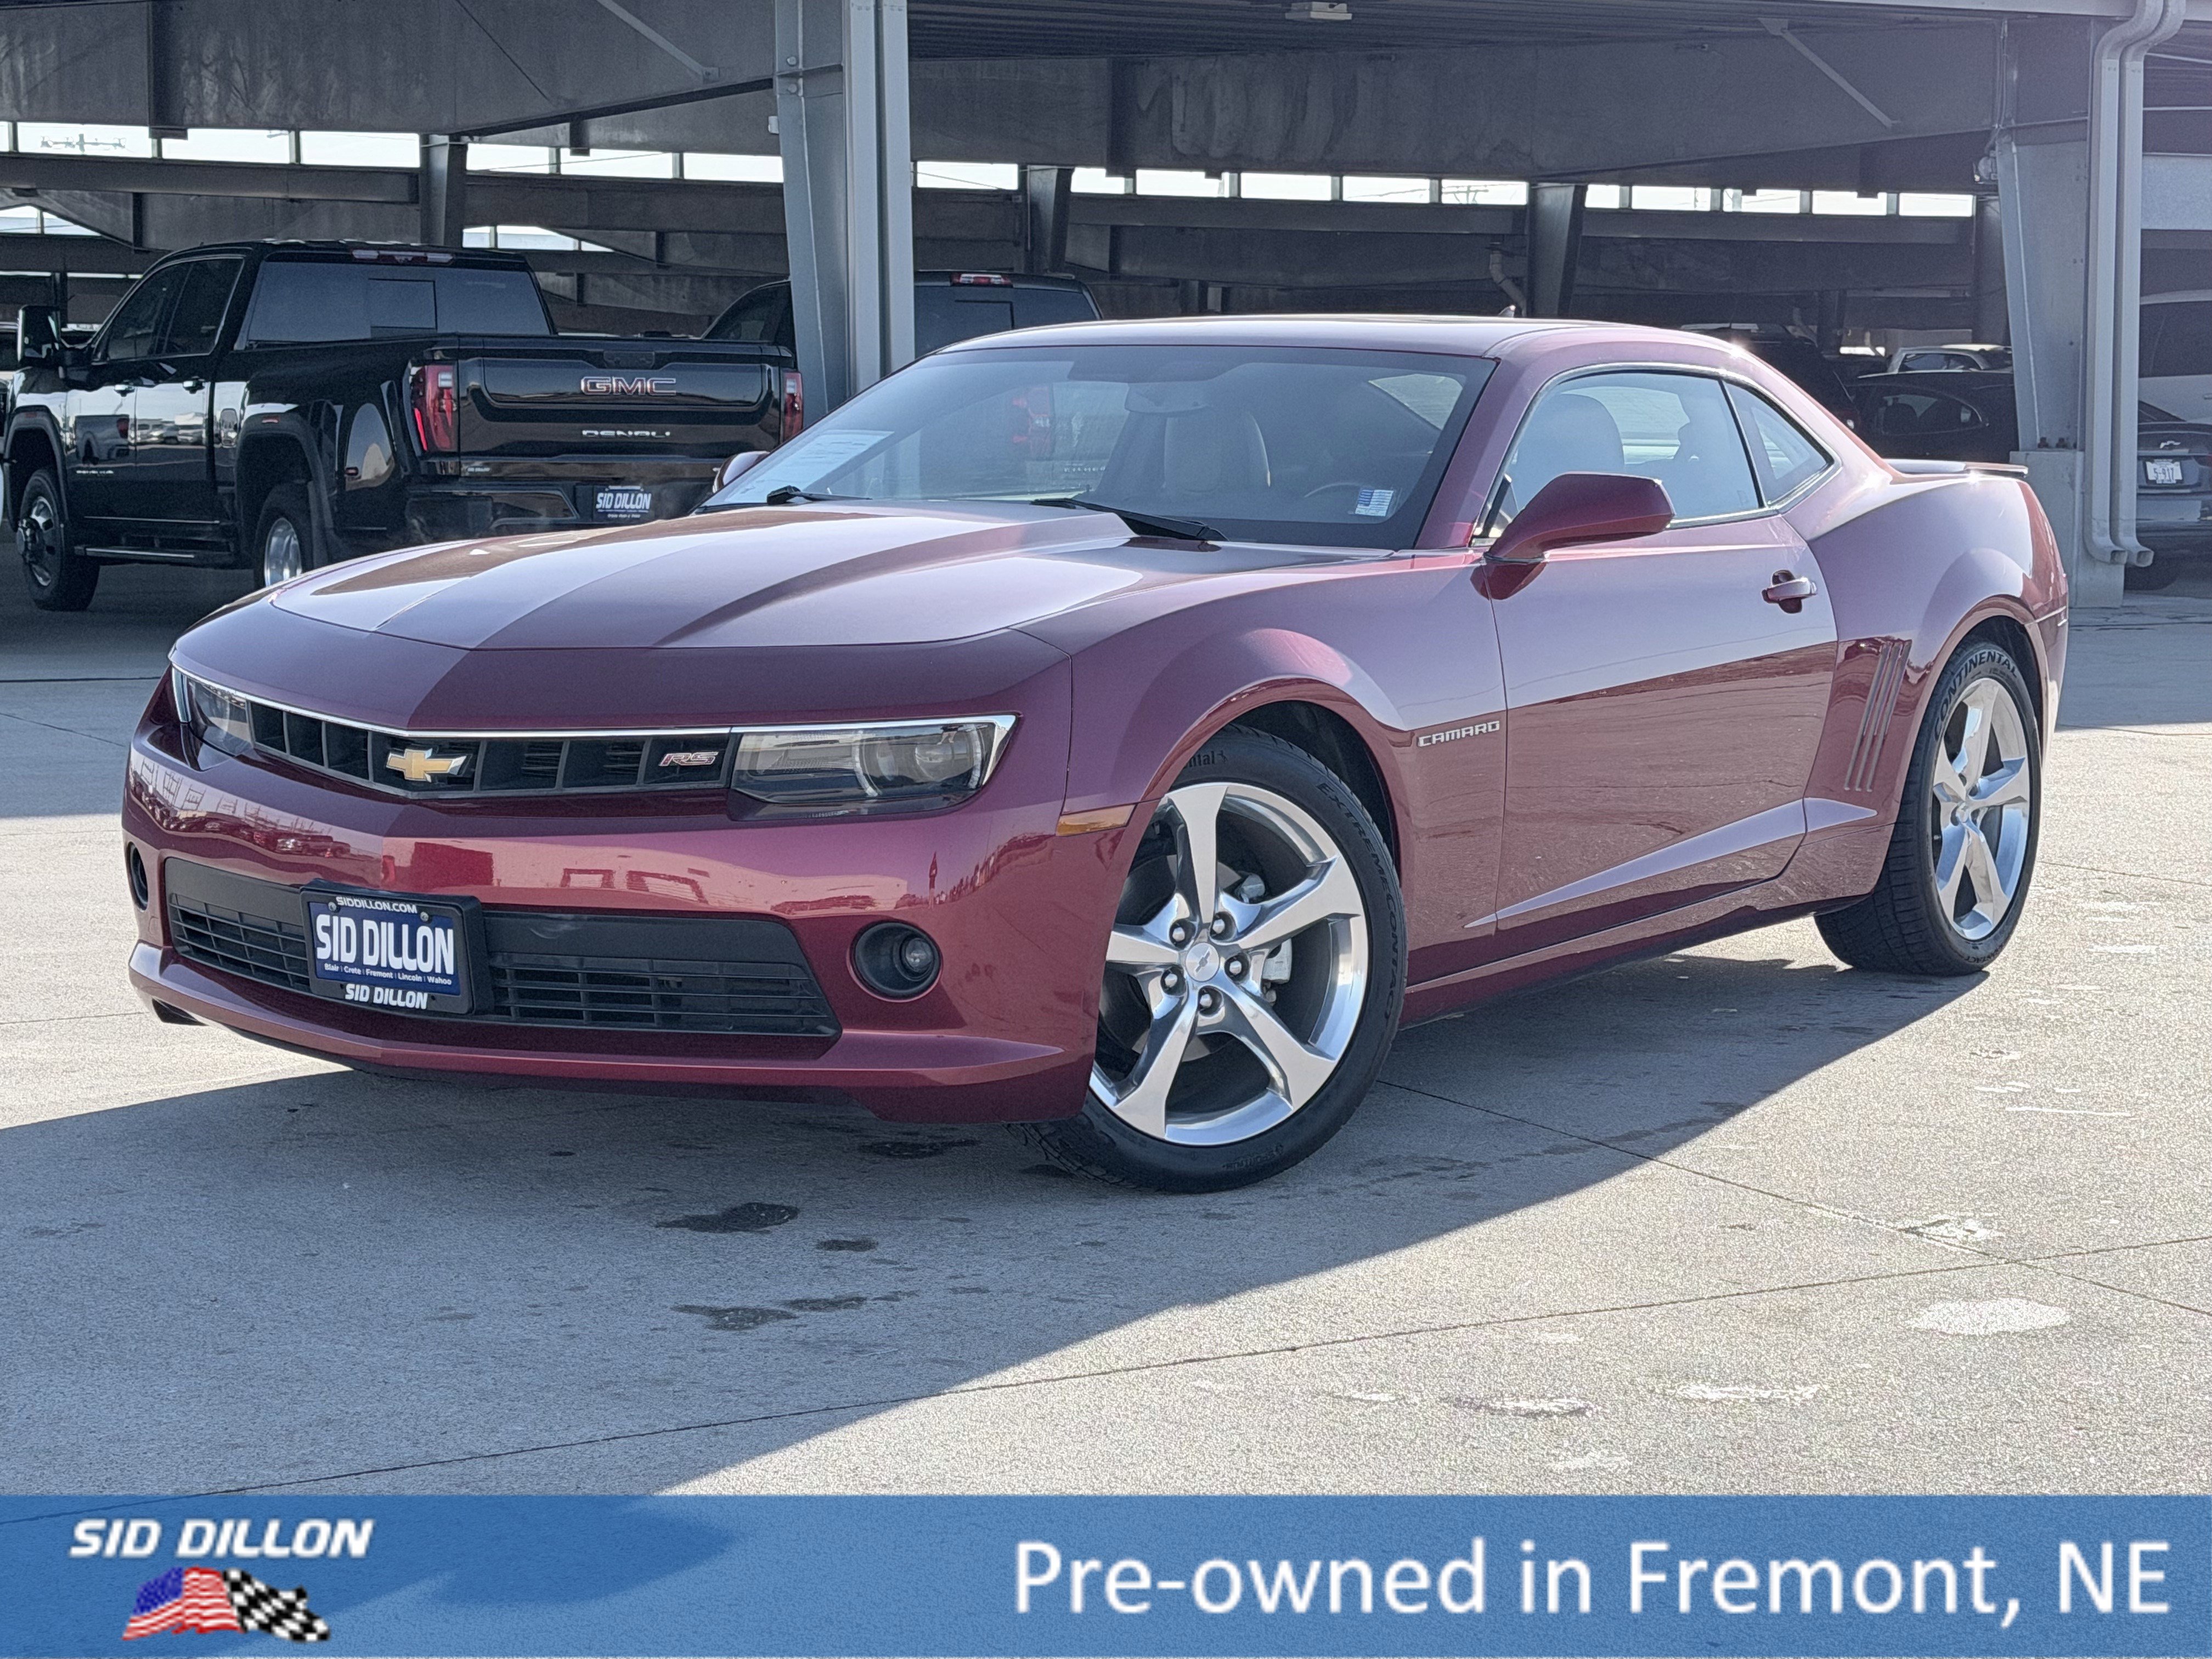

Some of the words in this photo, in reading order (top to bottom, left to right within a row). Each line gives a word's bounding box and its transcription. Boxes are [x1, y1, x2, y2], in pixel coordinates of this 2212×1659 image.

[581, 376, 676, 396] GMC
[596, 493, 613, 509] SID
[613, 493, 652, 510] DILLON
[1934, 649, 2018, 742] CONTINENTAL
[1418, 720, 1500, 747] CAMARO
[658, 752, 719, 766] RS
[336, 896, 417, 914] SIDDILLON.COM
[316, 914, 357, 963] SID
[363, 919, 454, 975] DILLON
[324, 963, 339, 972] Blair
[366, 968, 393, 979] Fremont
[398, 973, 422, 982] Lincoln
[427, 976, 452, 985] Wahoo
[345, 983, 370, 1002] SID
[373, 987, 428, 1009] DILLON
